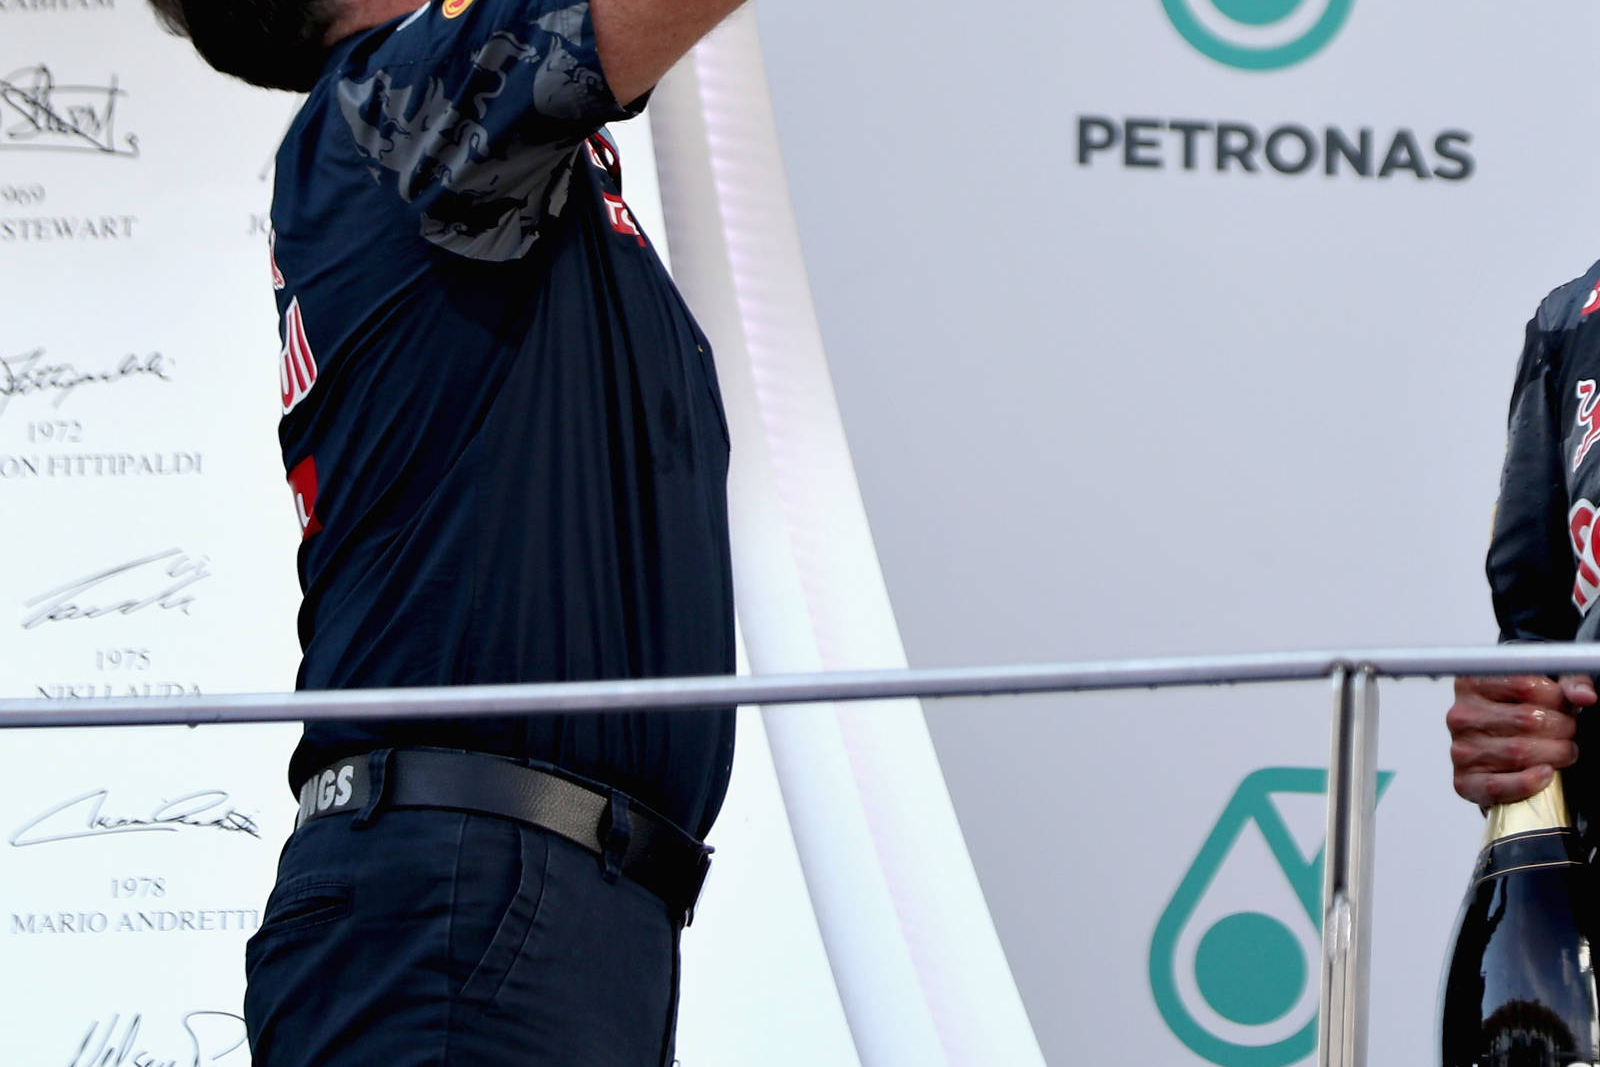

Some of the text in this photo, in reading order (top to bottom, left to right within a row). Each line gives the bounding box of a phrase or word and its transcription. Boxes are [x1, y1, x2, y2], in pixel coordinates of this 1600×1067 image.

[1076, 116, 1476, 181] PETRONAS
[0, 214, 137, 242] STEWART
[27, 420, 83, 444] 1972
[47, 451, 203, 478] FITTIPALDI
[95, 649, 151, 671] 1975
[111, 877, 166, 900] 1978
[11, 909, 260, 935] MARIO ANDRETTI
